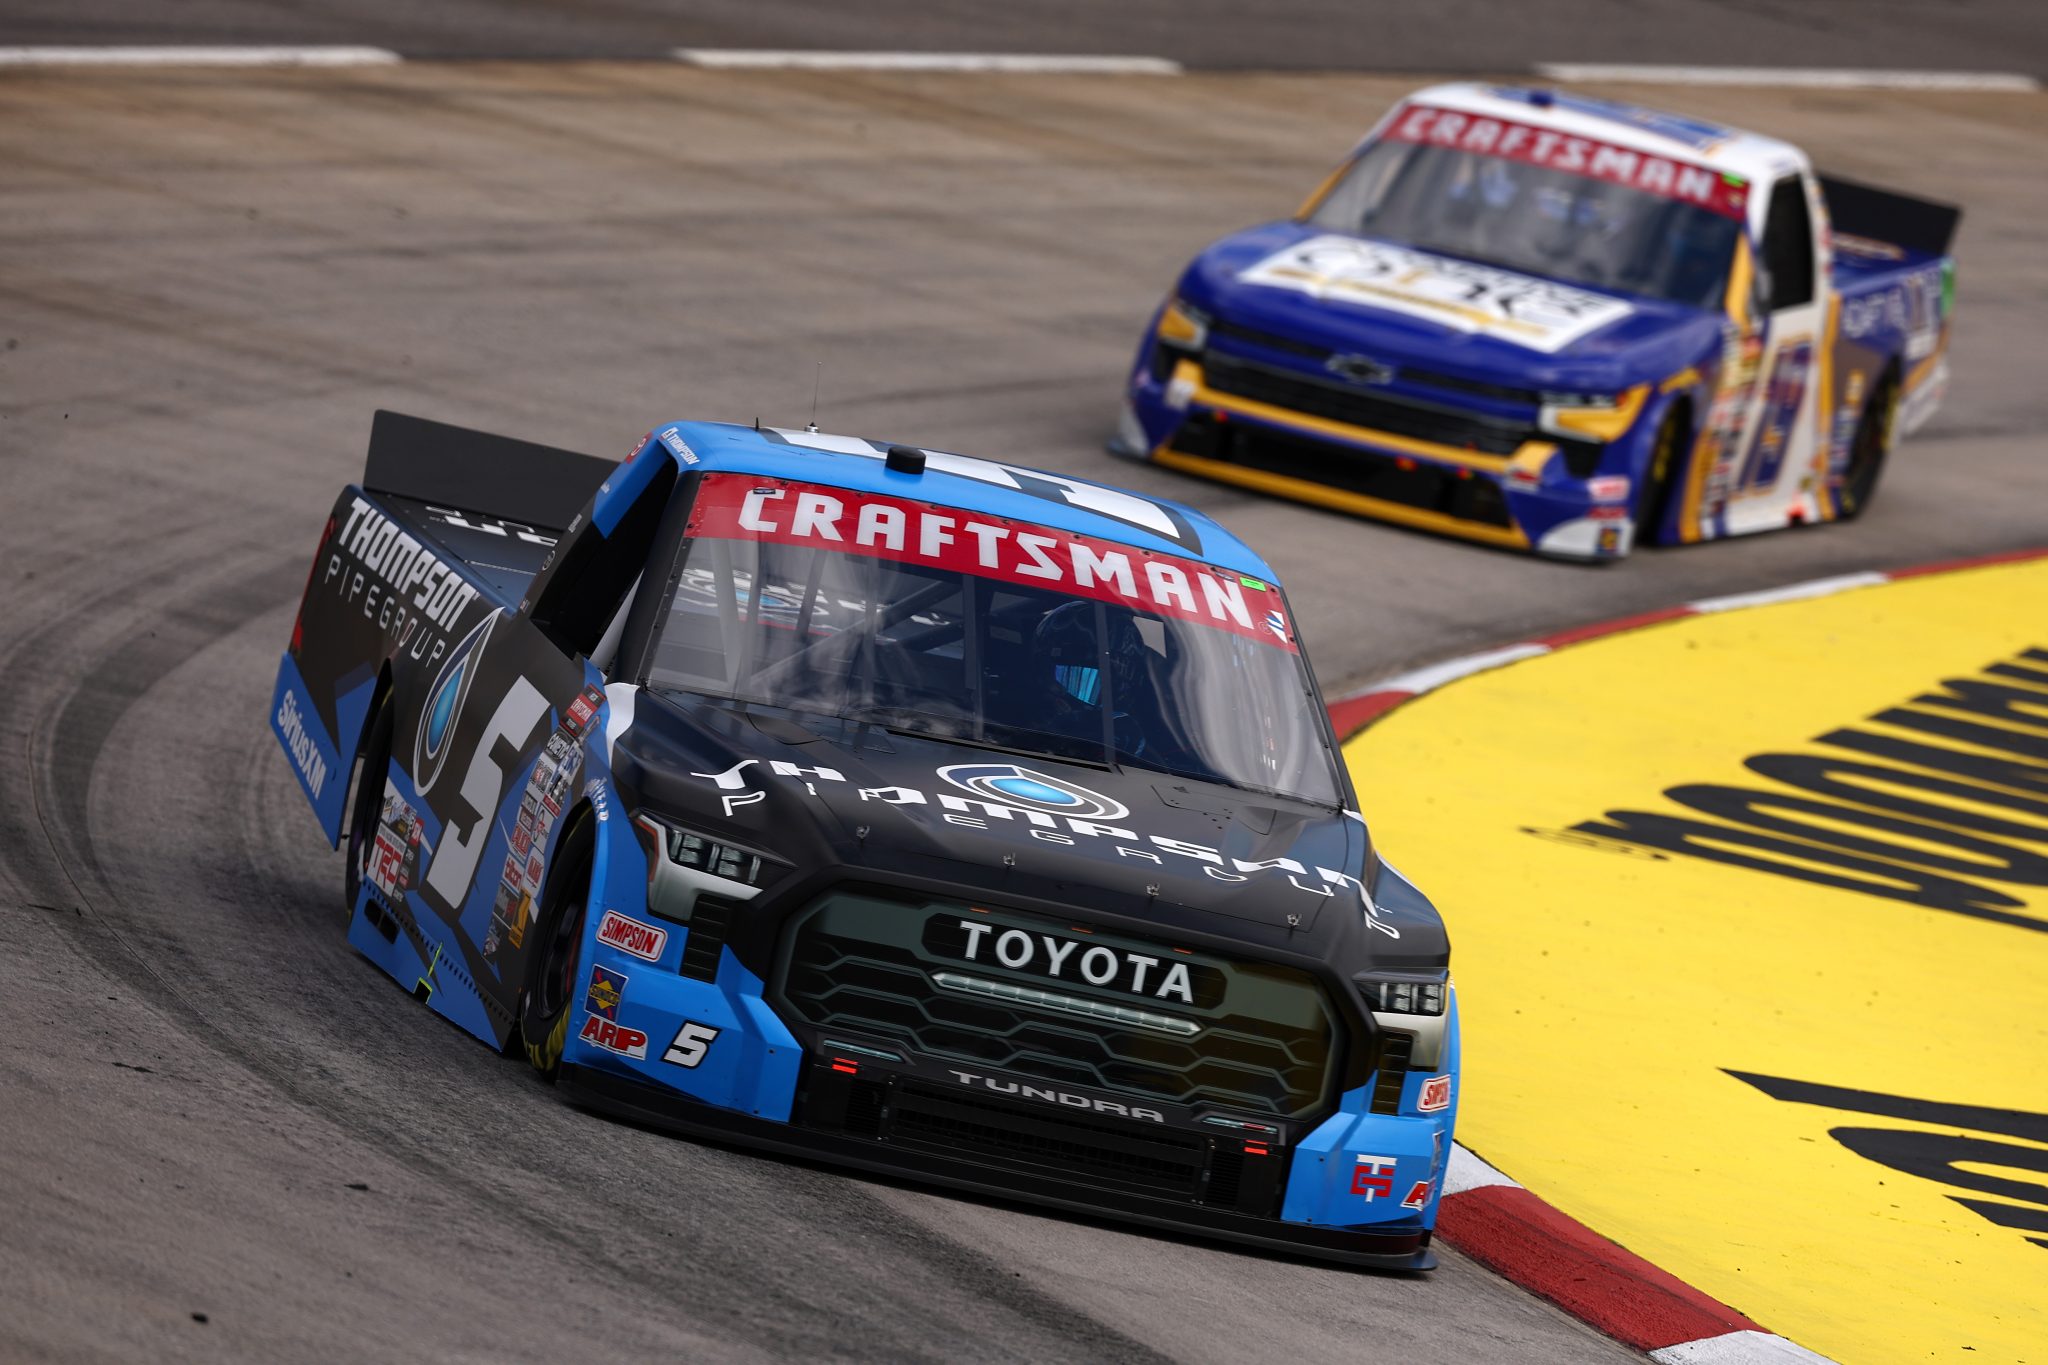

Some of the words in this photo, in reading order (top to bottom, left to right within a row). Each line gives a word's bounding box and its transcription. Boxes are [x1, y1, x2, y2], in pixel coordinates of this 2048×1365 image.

[1400, 107, 1715, 202] CRAFTSMAN
[339, 496, 472, 631] THOMPSON
[738, 489, 1255, 630] CRAFTSMAN
[324, 555, 446, 669] PIPEGROUP
[278, 690, 327, 800] SiriusXM
[426, 674, 551, 909] 5
[602, 916, 659, 953] SIMPSON
[960, 920, 1194, 1004] TOYOTA
[582, 1016, 647, 1051] ARP
[663, 1022, 719, 1068] 5
[949, 1069, 1165, 1123] TUNDRA
